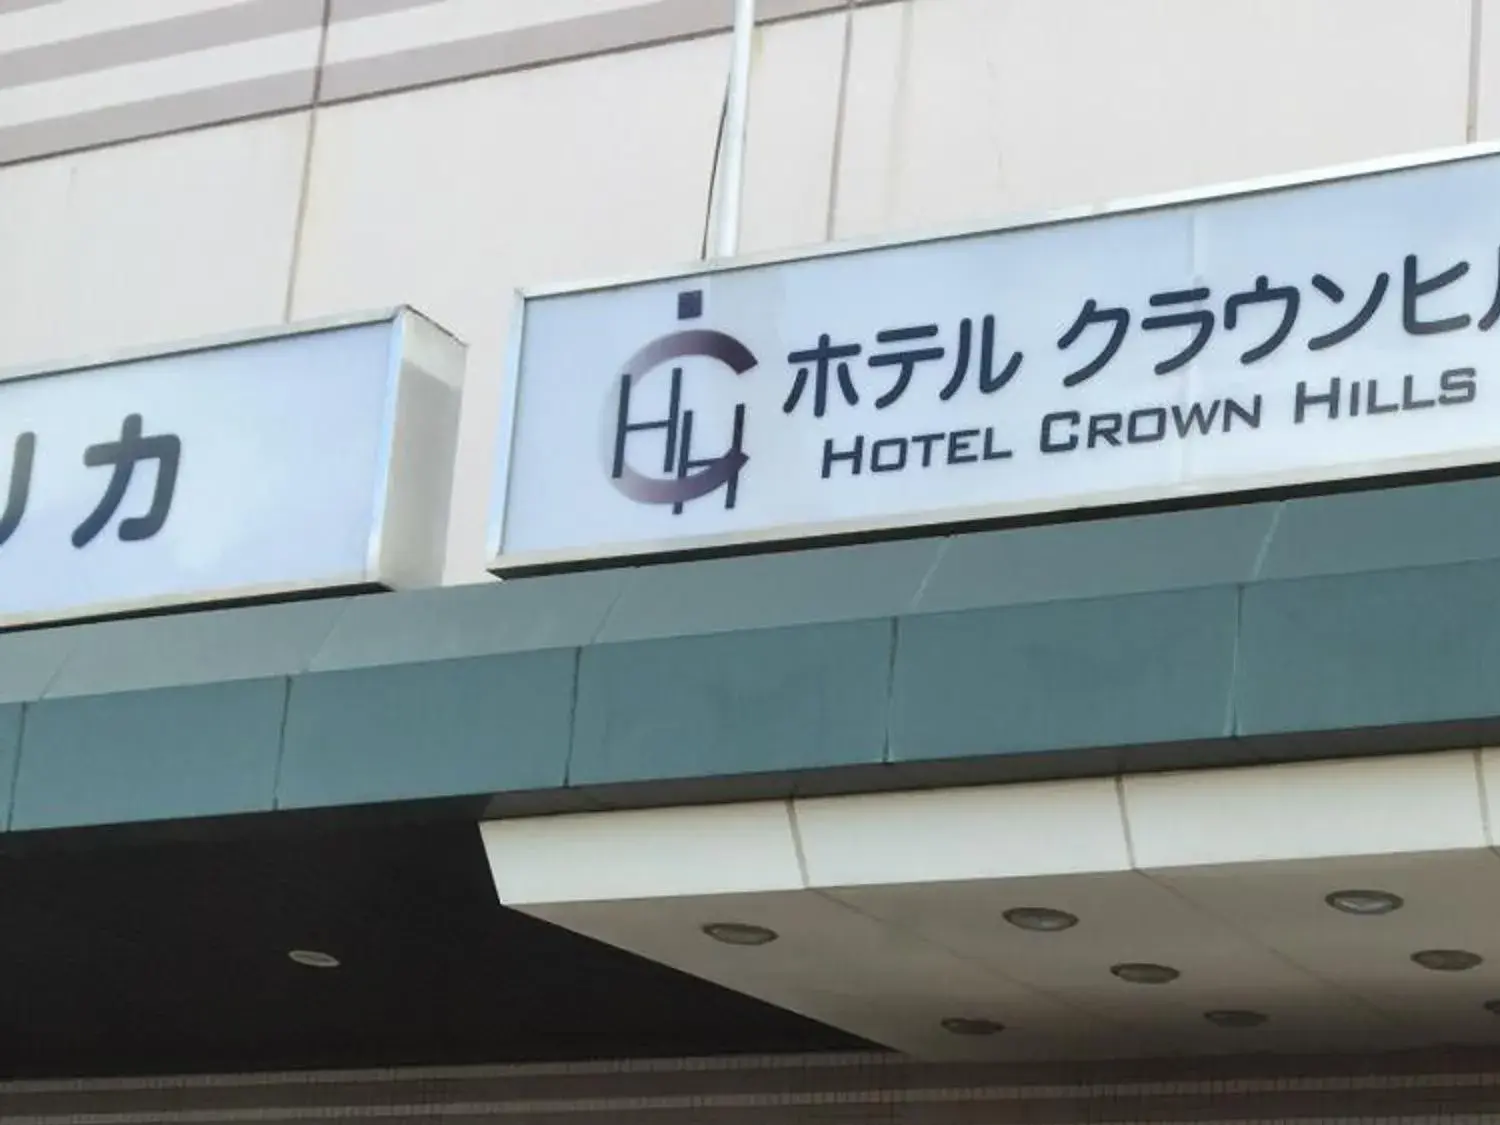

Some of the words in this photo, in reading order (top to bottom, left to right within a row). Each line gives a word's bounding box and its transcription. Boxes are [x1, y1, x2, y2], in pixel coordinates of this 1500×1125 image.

[783, 314, 1023, 418] ホテル
[821, 427, 1013, 479] HOTEL
[1039, 394, 1262, 454] CROWN
[1294, 366, 1478, 424] HILLS
